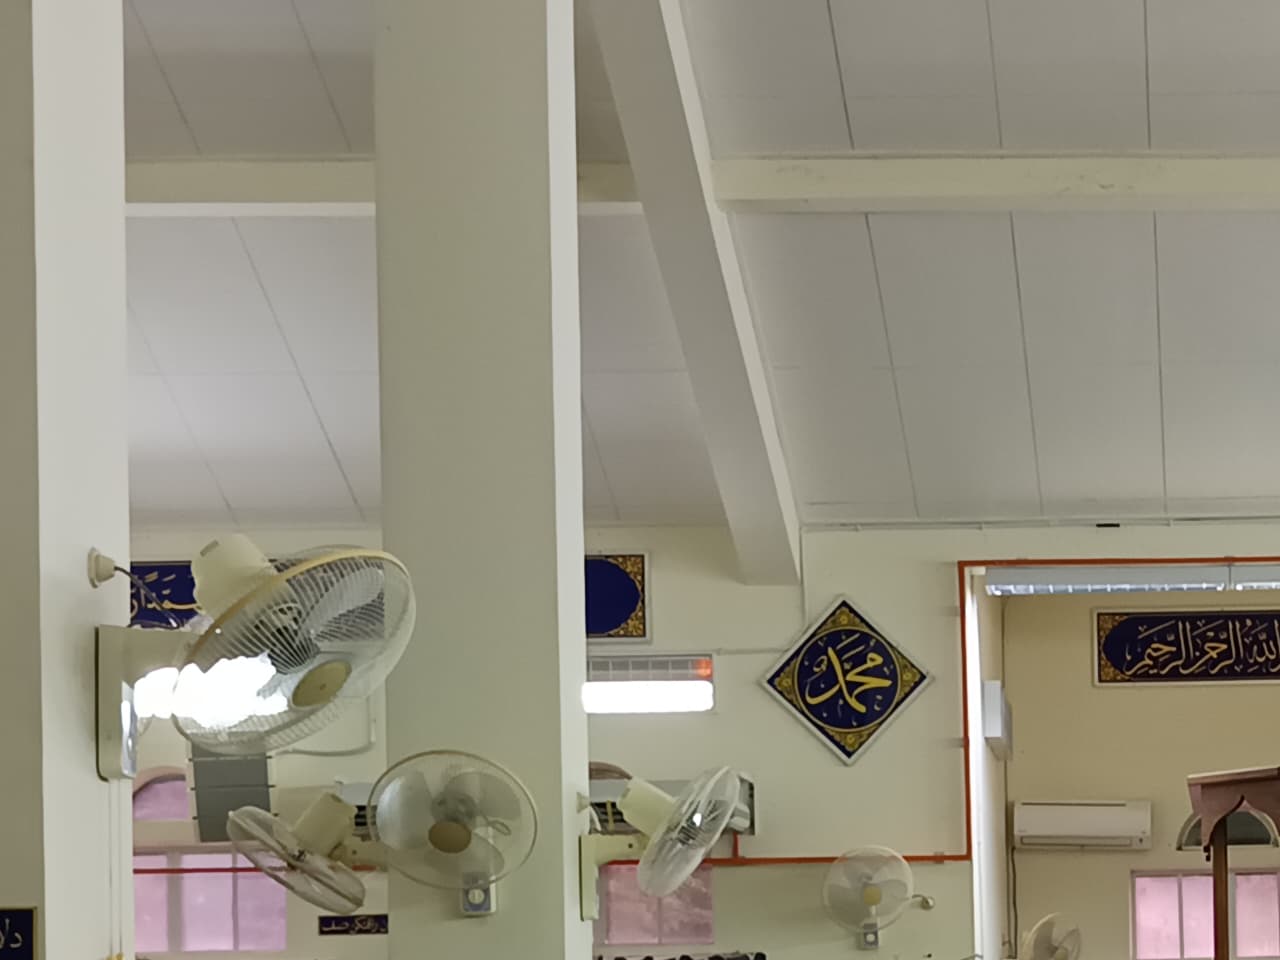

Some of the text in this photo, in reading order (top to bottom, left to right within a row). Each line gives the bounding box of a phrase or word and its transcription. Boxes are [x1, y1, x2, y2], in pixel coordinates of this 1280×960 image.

[1124, 620, 1193, 676] الرحيم
[1179, 620, 1246, 675] الرحمن
[805, 640, 893, 714] محمد
